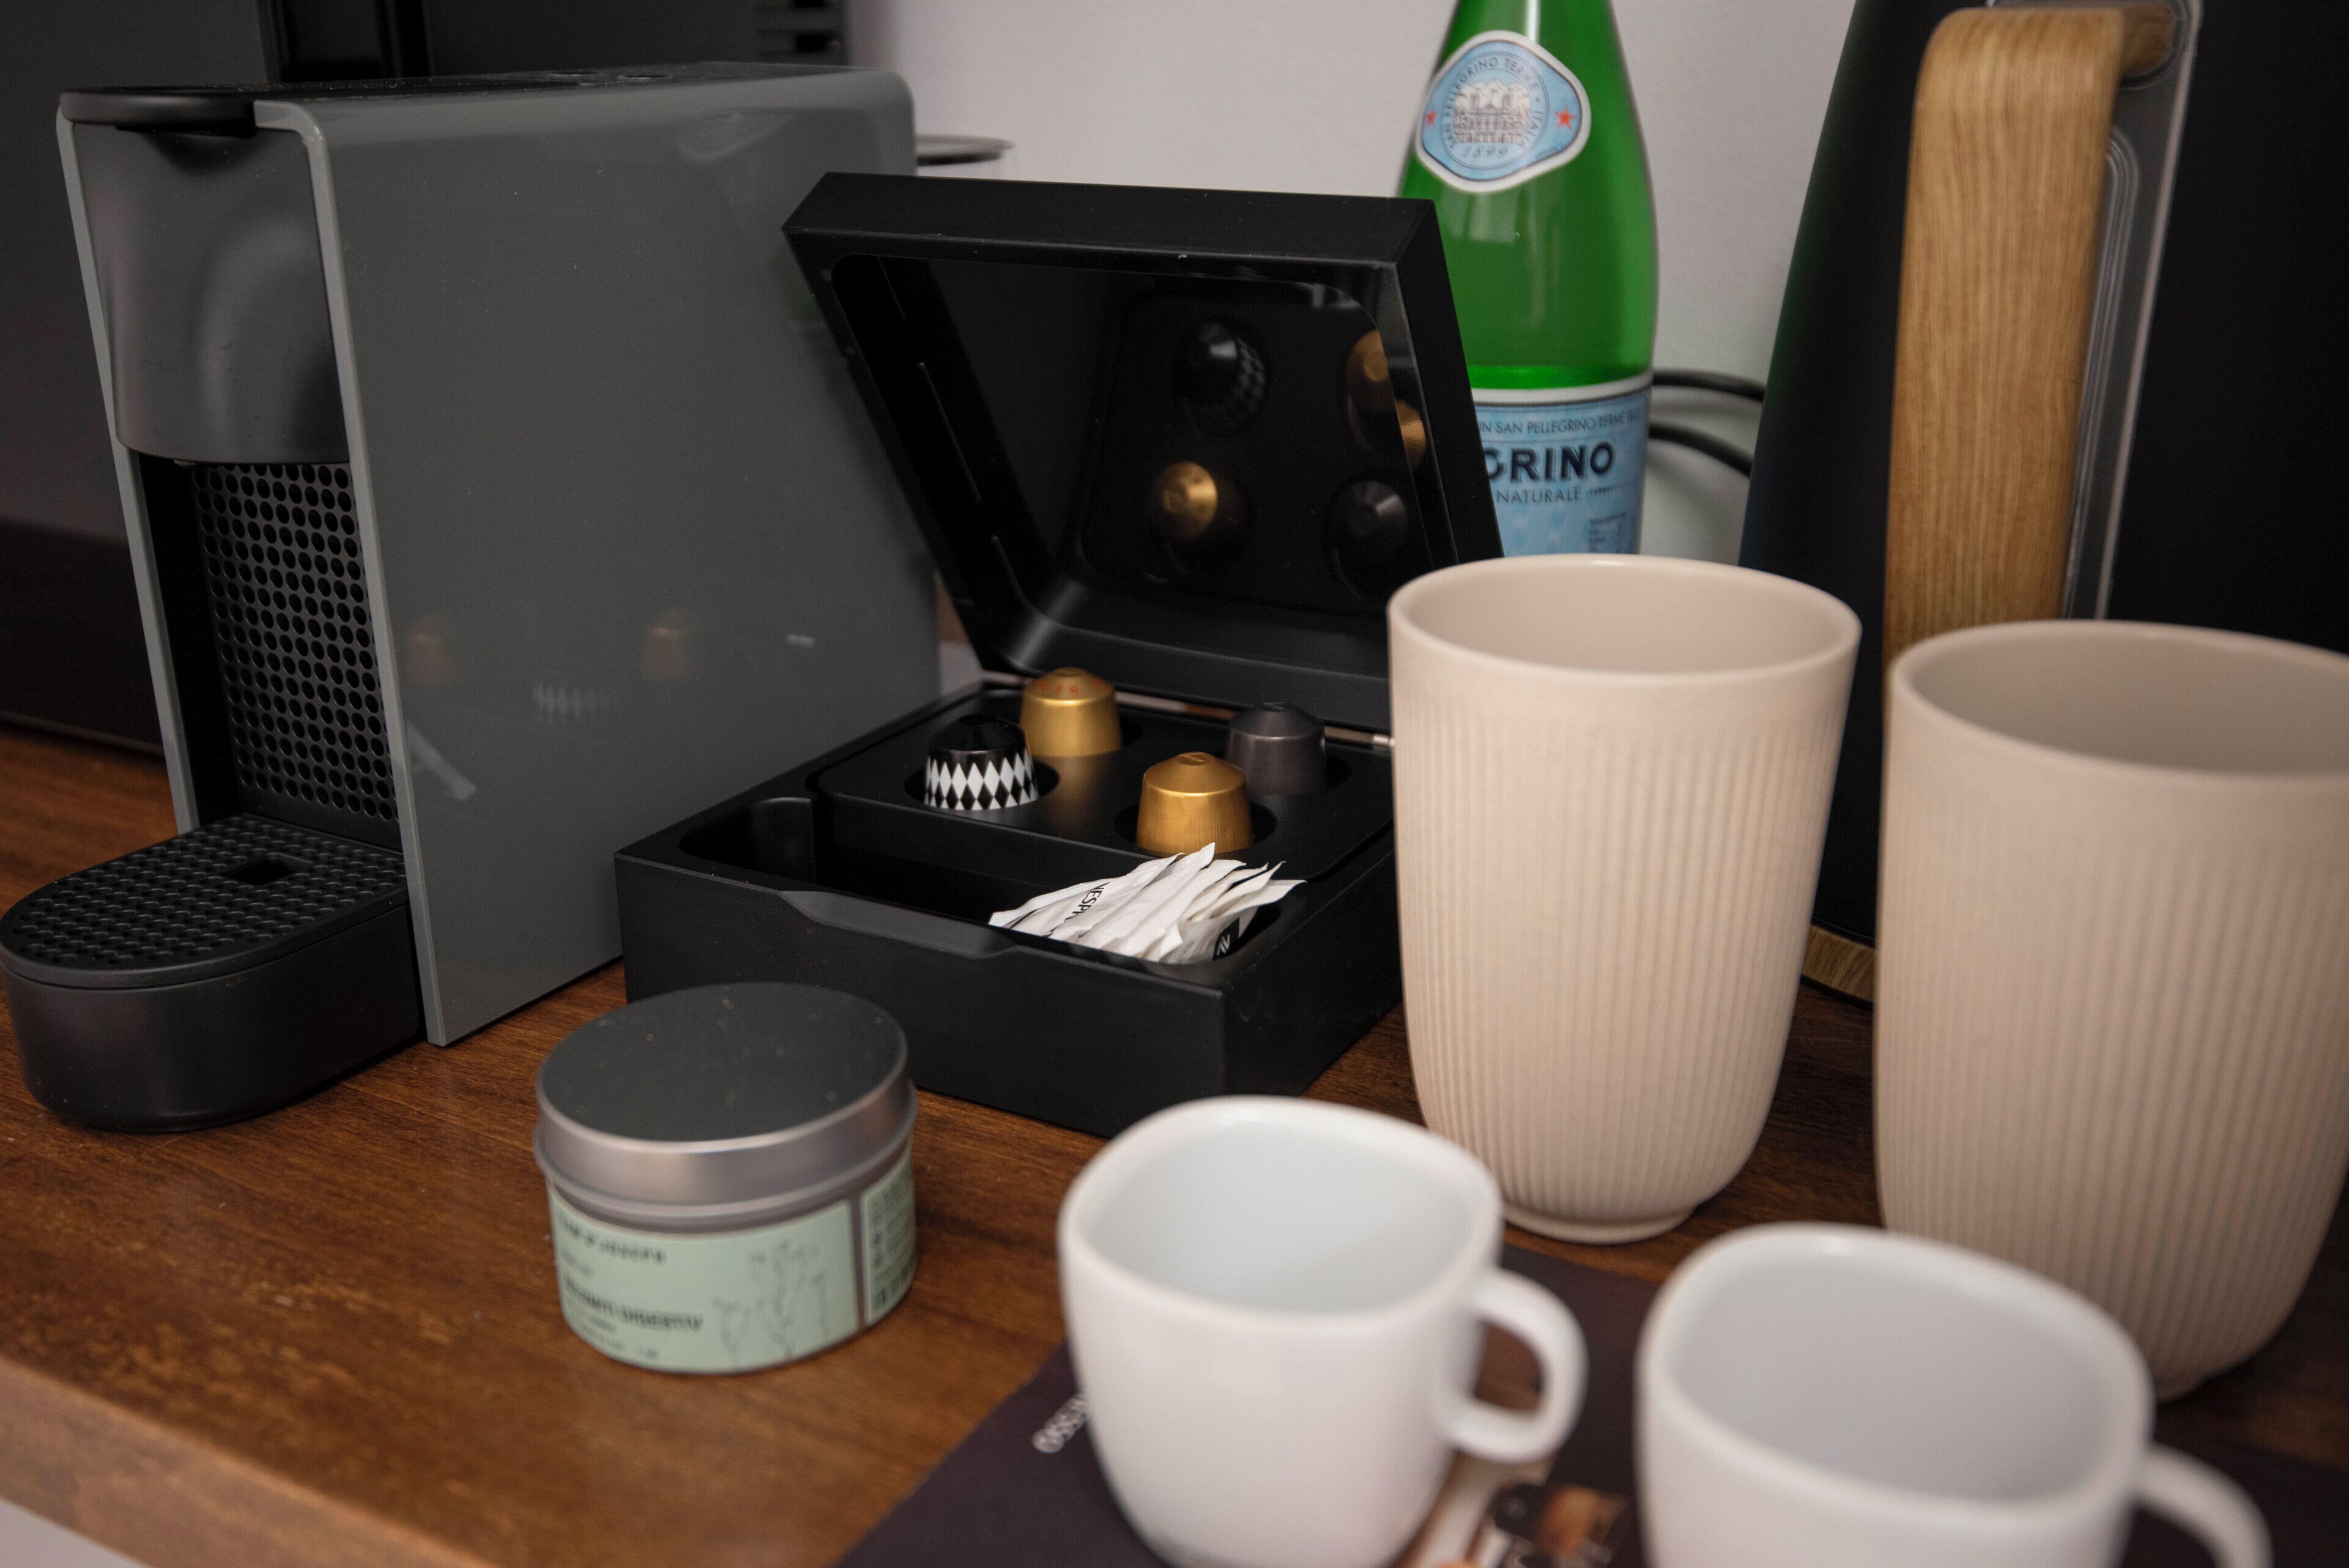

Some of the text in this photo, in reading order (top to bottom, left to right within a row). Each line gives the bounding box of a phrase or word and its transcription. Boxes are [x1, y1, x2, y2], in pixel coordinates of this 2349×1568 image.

[1496, 422, 1523, 434] SAN
[1527, 417, 1596, 433] PELLEGRINO
[1497, 487, 1581, 504] NATURALE
